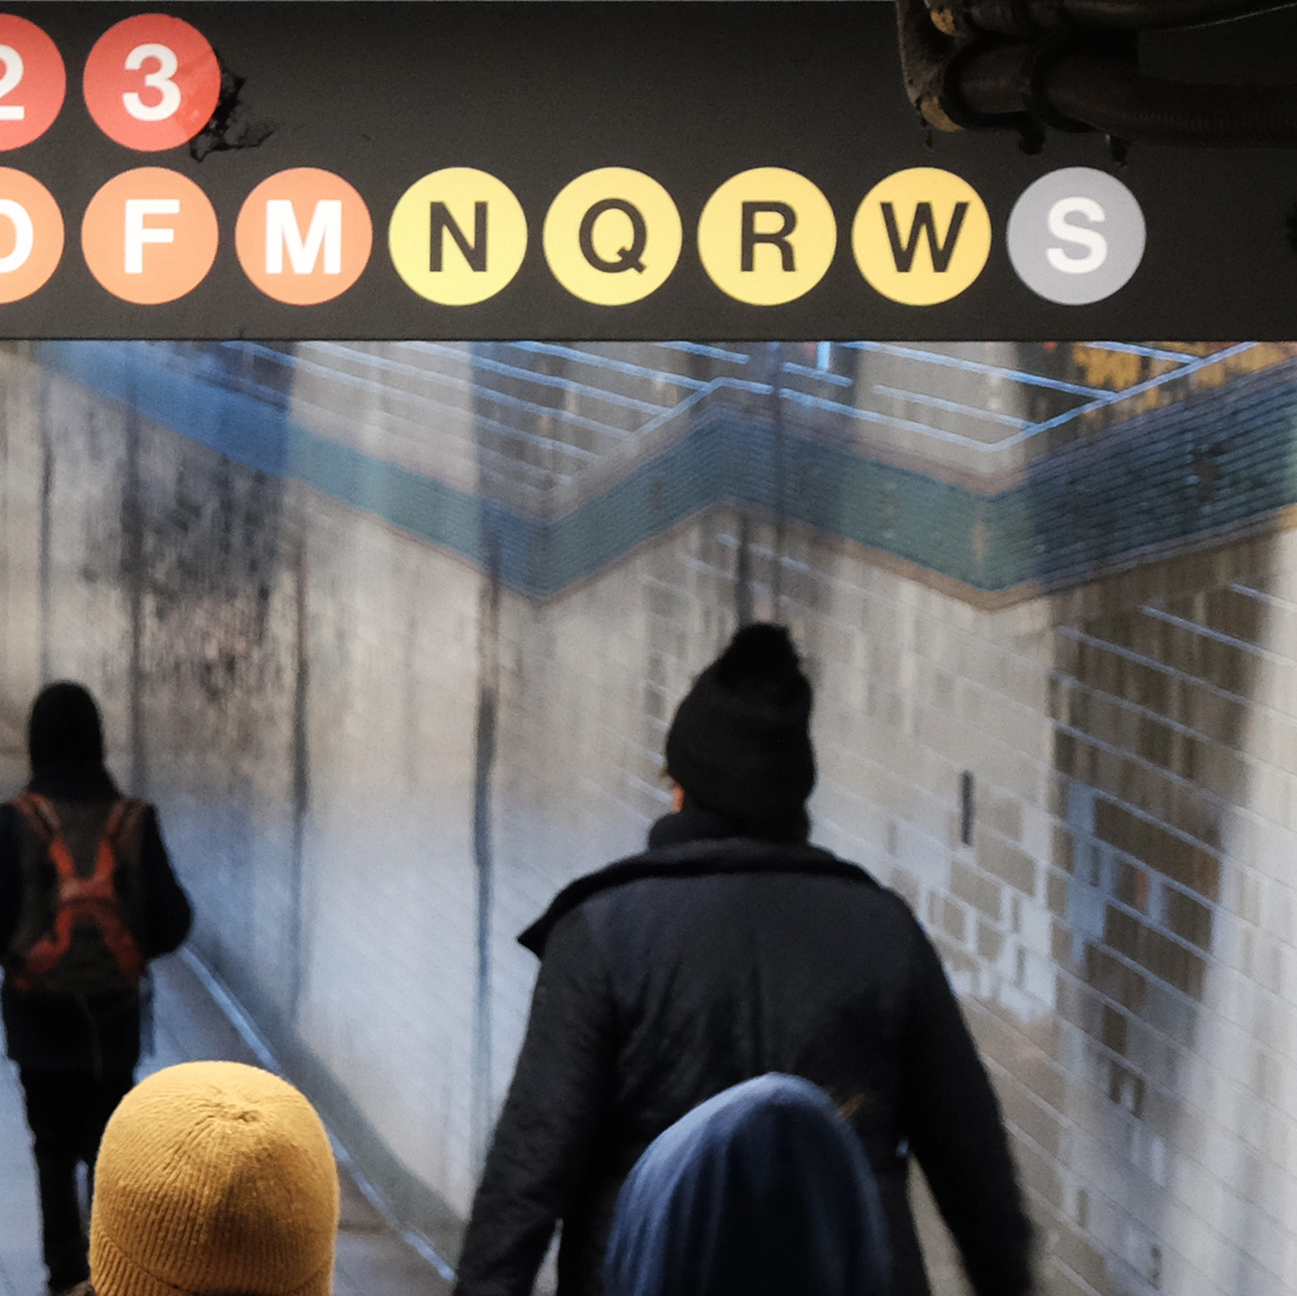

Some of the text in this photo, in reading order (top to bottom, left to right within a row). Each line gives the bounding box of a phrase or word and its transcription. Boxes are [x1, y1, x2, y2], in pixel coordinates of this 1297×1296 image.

[122, 44, 181, 122] 3
[123, 198, 181, 275] F
[264, 199, 343, 275] M
[428, 200, 489, 274] N
[578, 197, 649, 276] Q
[739, 199, 798, 274] R
[880, 200, 970, 275] W
[1044, 196, 1109, 276] S
